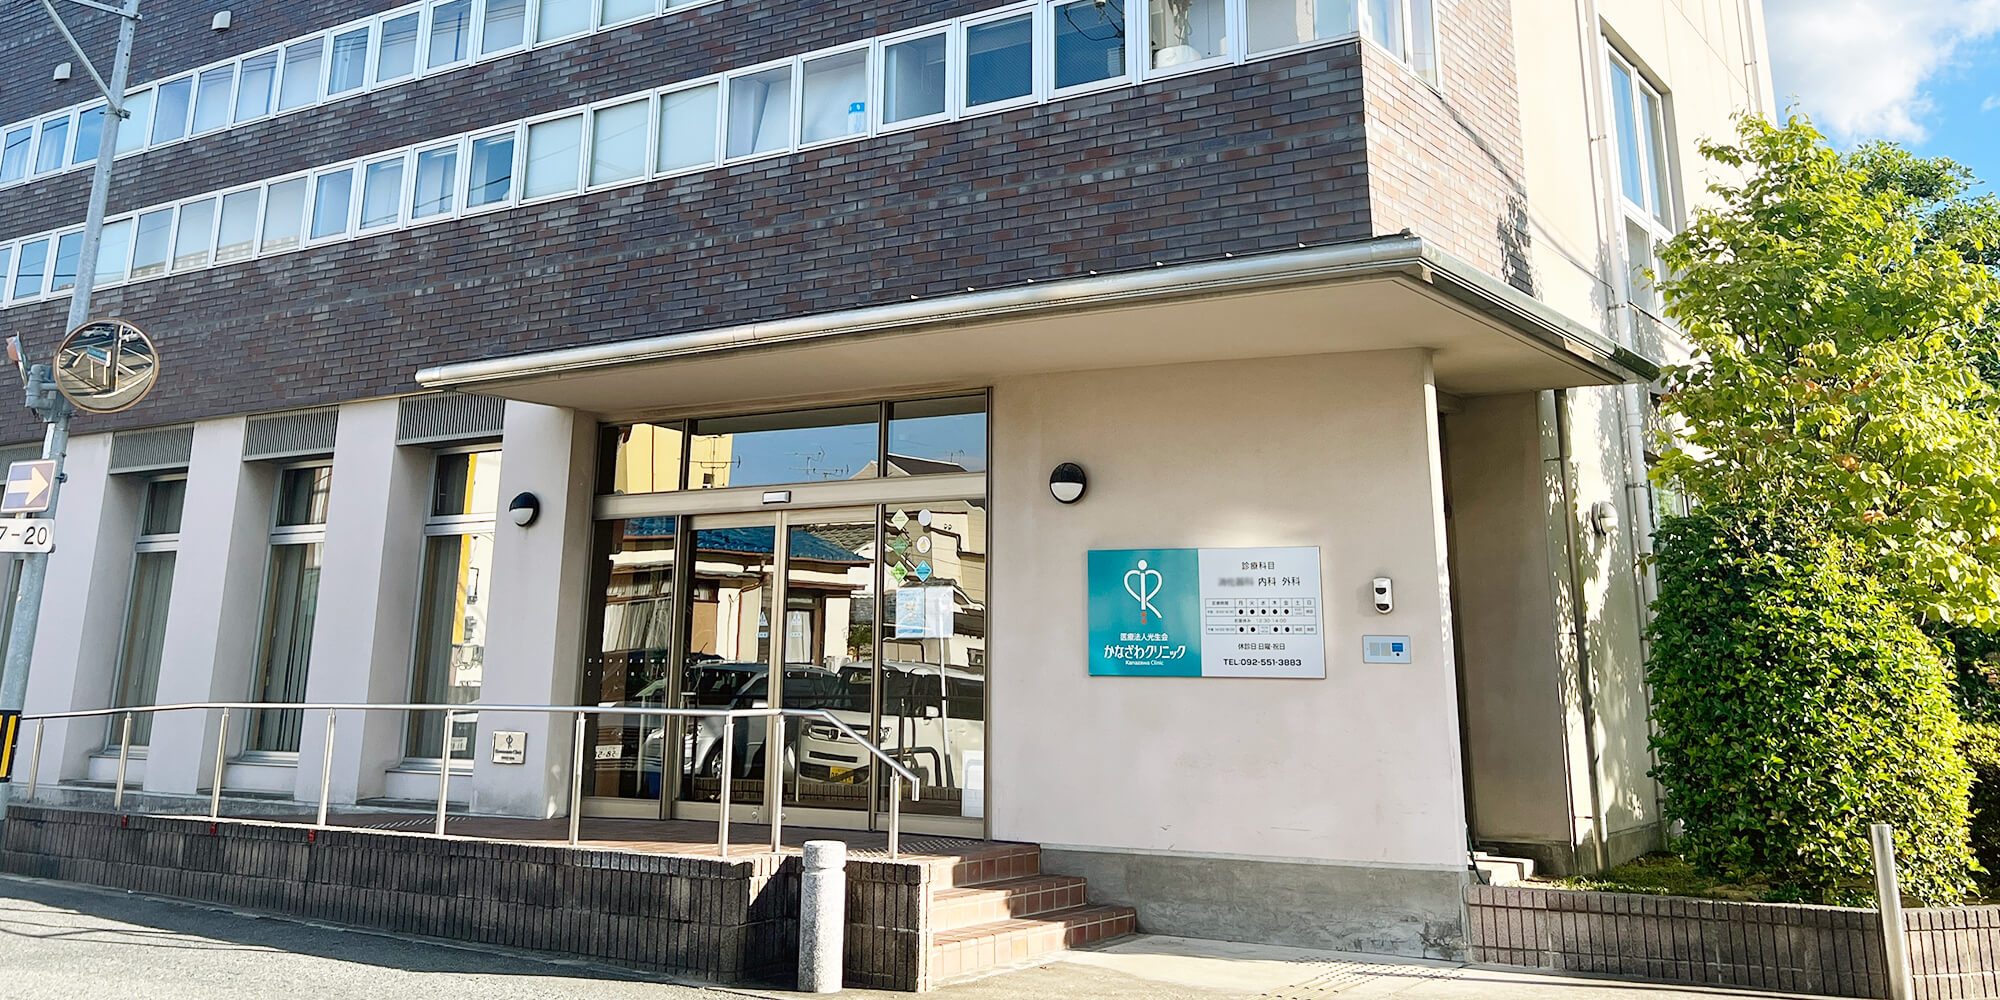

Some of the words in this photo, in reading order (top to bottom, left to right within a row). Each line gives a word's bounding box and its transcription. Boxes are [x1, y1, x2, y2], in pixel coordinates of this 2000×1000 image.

[1241, 561, 1275, 570] 診療科目
[1258, 576, 1276, 586] 内科
[1282, 576, 1301, 586] 外科
[1120, 632, 1168, 641] 医療法人光生会
[1104, 644, 1186, 659] かなざわクリニック
